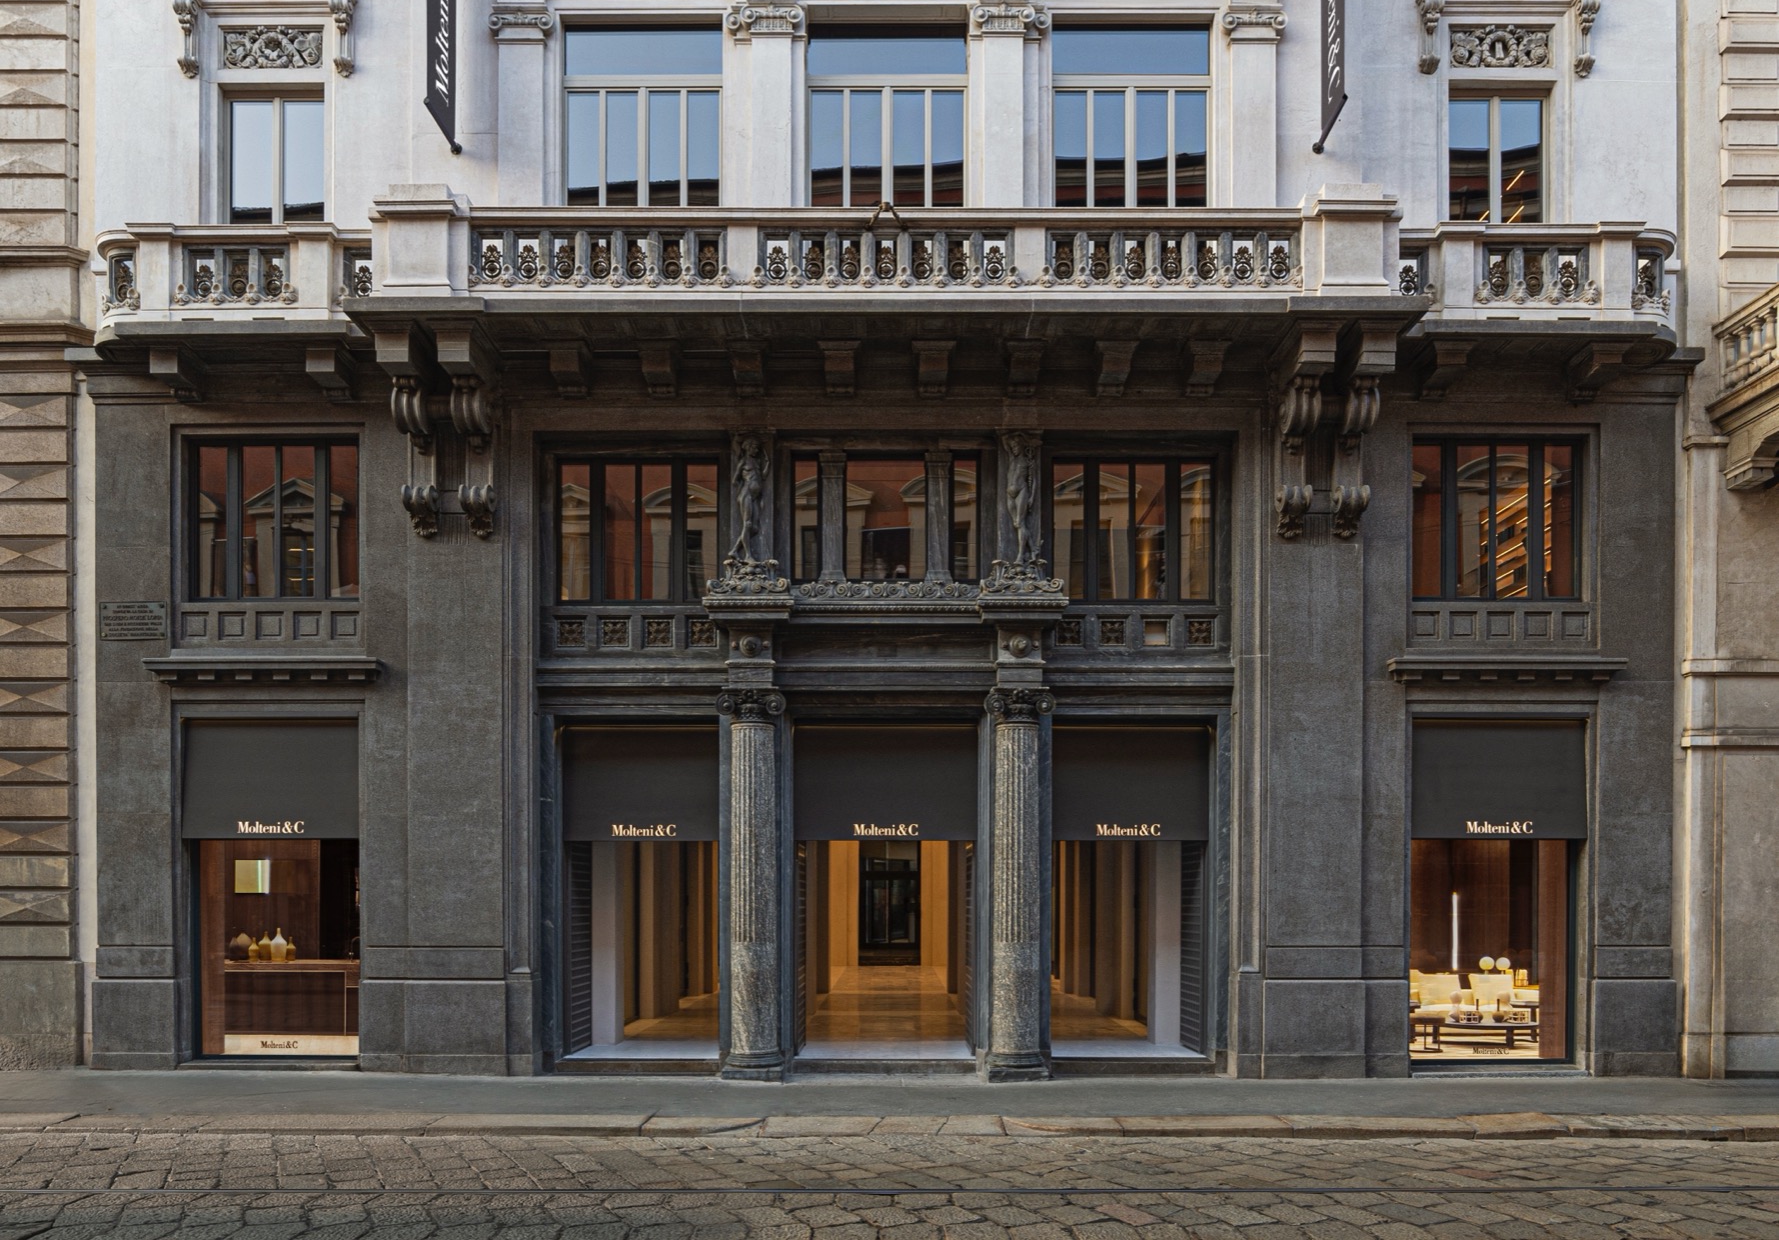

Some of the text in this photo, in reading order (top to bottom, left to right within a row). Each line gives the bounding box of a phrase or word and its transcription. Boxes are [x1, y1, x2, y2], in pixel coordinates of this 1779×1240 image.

[237, 821, 304, 834] Molteni&C
[611, 823, 676, 837] Molteni&C
[853, 823, 919, 837] Molteni&C
[1096, 823, 1161, 837] Molteni&C
[1466, 821, 1533, 834] Molteni&C
